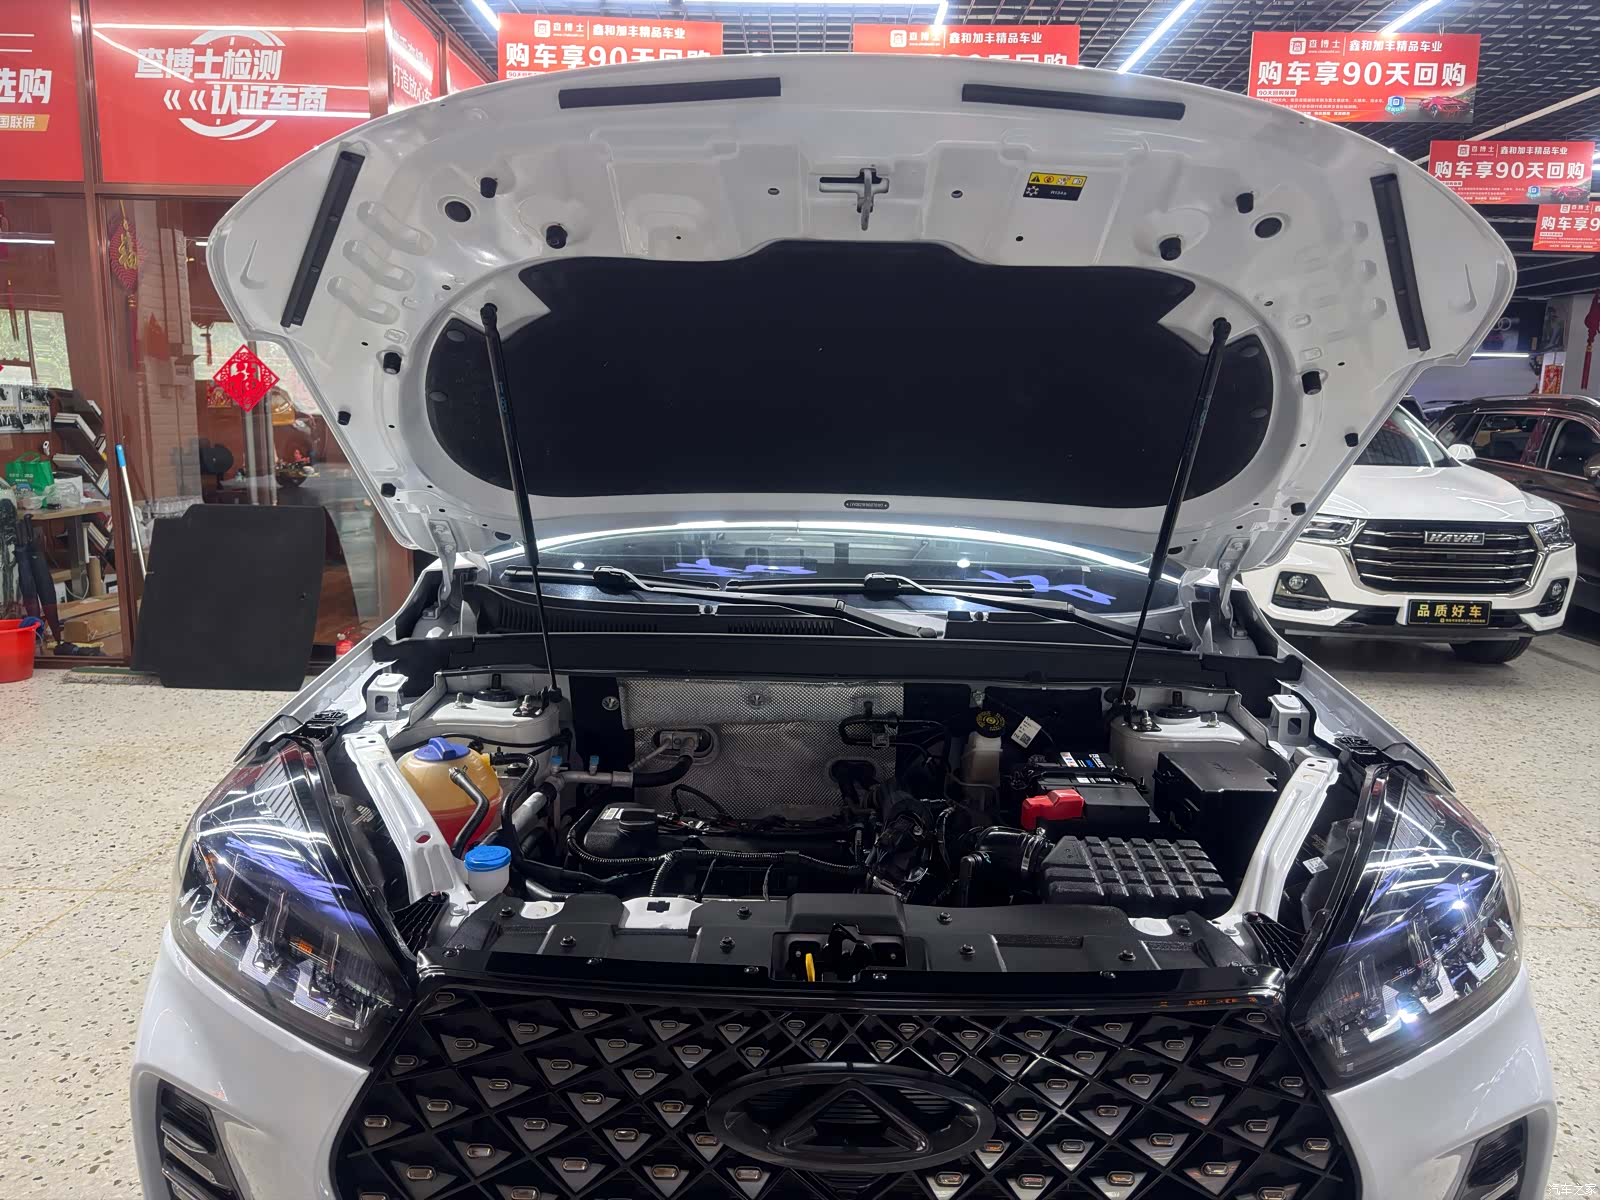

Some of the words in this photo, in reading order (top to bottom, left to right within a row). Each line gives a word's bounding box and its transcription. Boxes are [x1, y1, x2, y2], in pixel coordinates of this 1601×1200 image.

[592, 24, 686, 39] 鑫和加丰精品车业
[949, 31, 1043, 44] 鑫和加丰精品车业
[1309, 39, 1341, 48] 查博士
[1349, 40, 1443, 52] 鑫和加丰精品车业
[134, 48, 284, 81] 查博士检测
[1256, 60, 1467, 87] 购车享90天回购
[210, 85, 328, 116] 认证车商
[1434, 160, 1585, 179] 购车享90天回购
[1428, 533, 1482, 543] HAVAL
[1416, 603, 1482, 618] 品质好车
